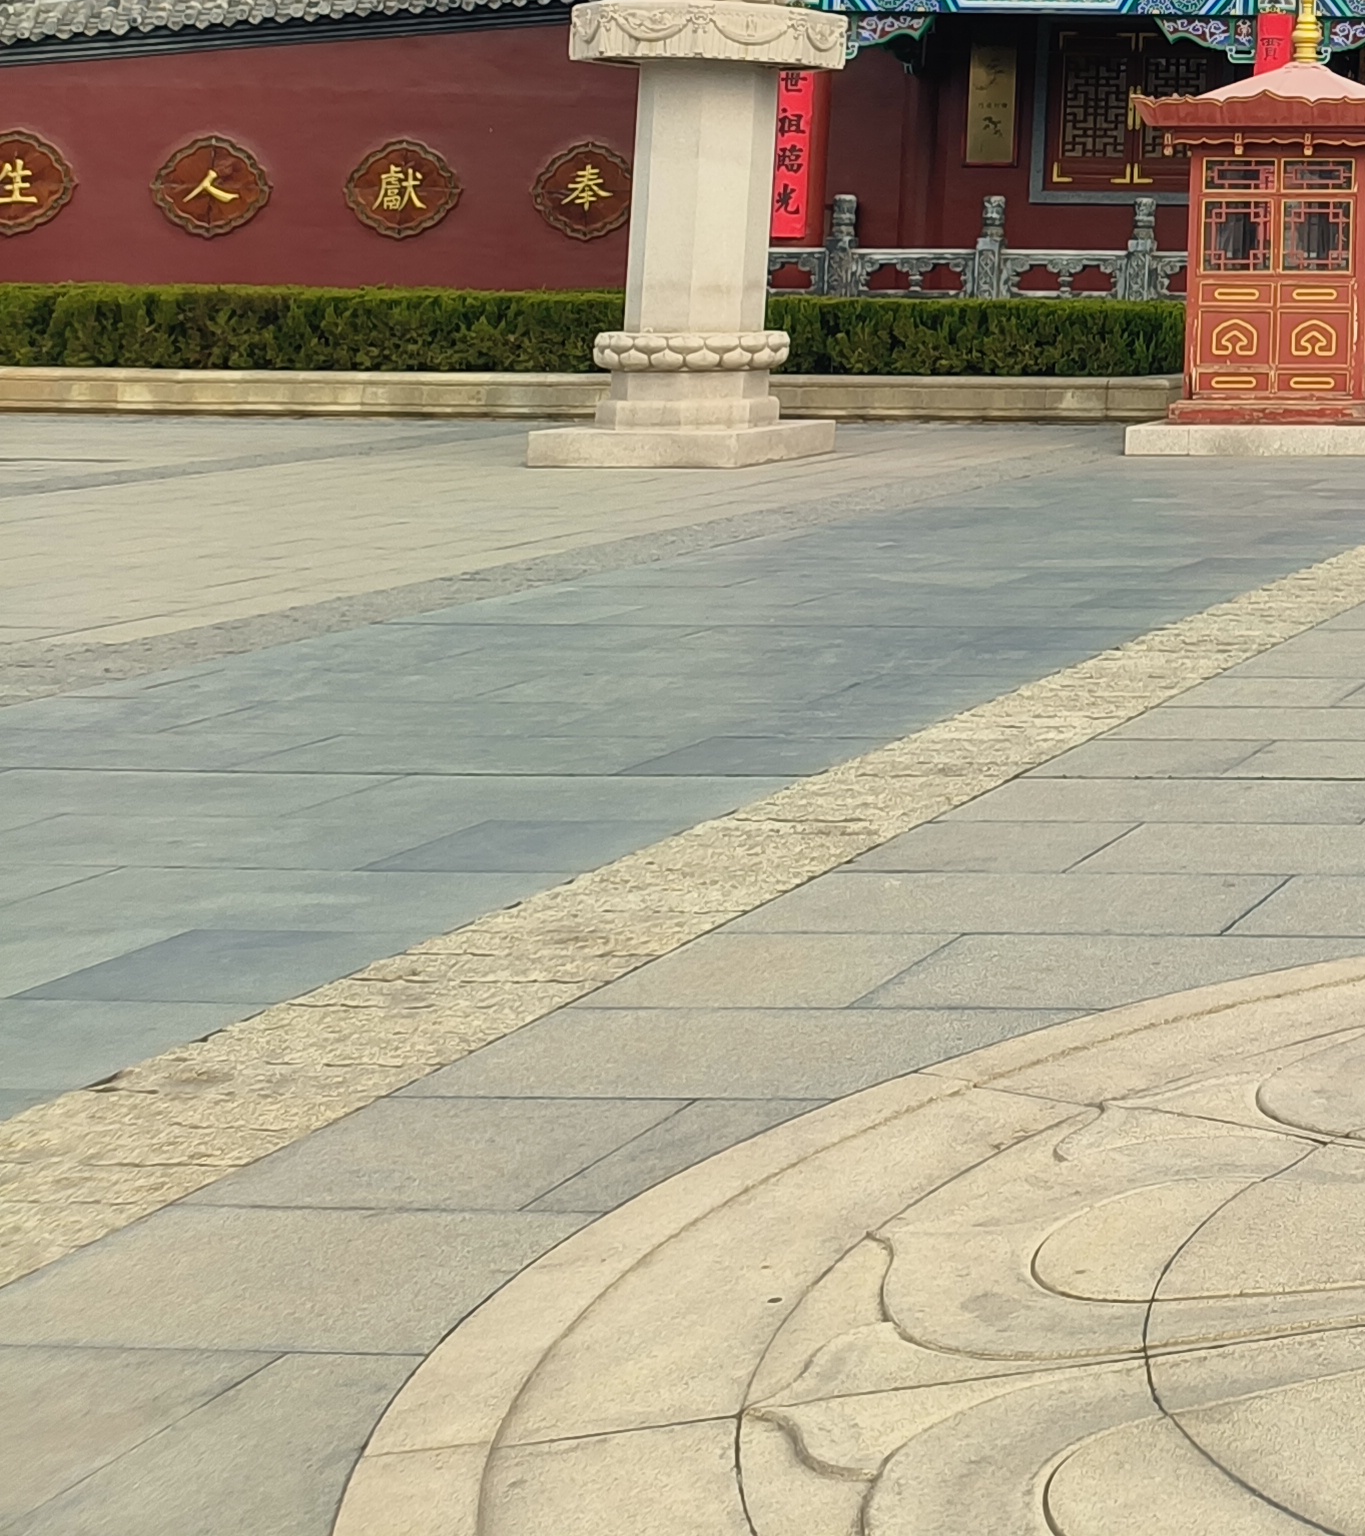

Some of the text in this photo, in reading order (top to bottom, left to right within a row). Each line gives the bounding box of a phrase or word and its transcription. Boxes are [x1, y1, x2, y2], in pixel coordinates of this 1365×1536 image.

[0, 158, 613, 212] 奉 獻 人 生
[775, 71, 808, 215] 世祖臨光
